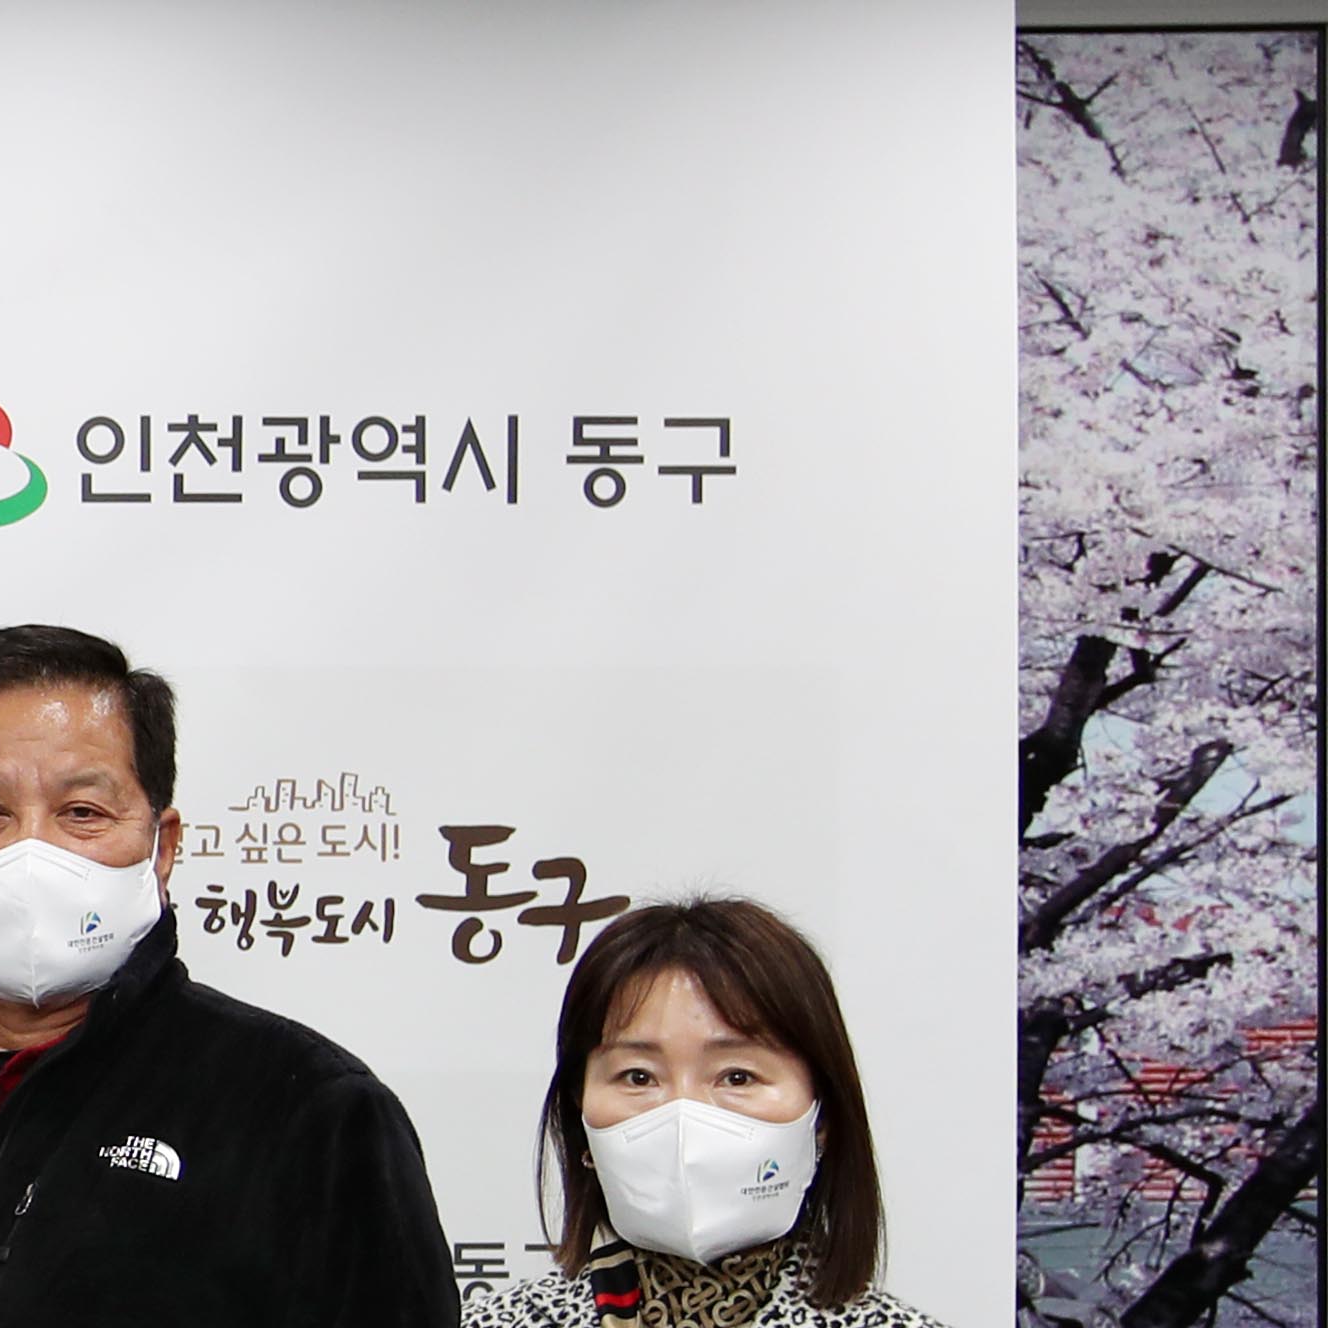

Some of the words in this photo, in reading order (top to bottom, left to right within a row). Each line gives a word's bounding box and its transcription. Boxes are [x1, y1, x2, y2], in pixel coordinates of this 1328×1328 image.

[75, 413, 519, 508] 인천광역시
[565, 415, 738, 508] 동구
[235, 822, 306, 864] 싶은
[317, 822, 400, 862] 도시!
[195, 880, 395, 957] 행복도시
[415, 825, 630, 964] 동구
[99, 1146, 153, 1161] NORTH
[126, 1135, 156, 1150] THE
[110, 1157, 149, 1172] FACE
